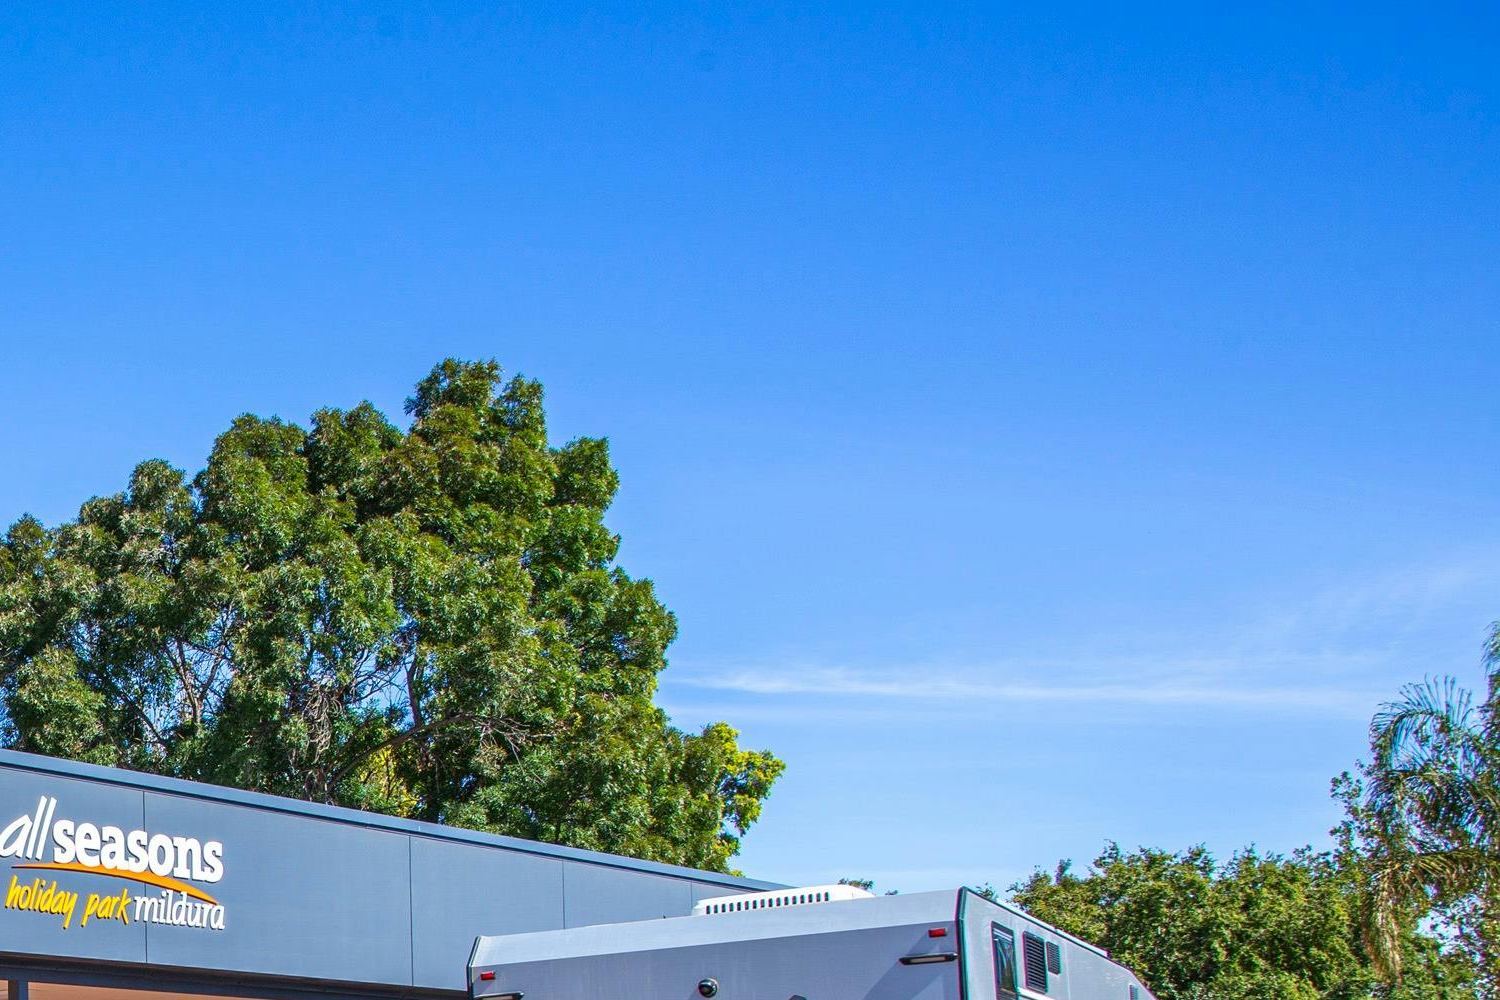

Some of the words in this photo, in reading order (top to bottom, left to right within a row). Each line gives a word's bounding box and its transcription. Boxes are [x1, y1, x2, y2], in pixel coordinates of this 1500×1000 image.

[4, 875, 78, 929] holiday
[80, 888, 133, 927] park
[134, 889, 226, 930] mildura
